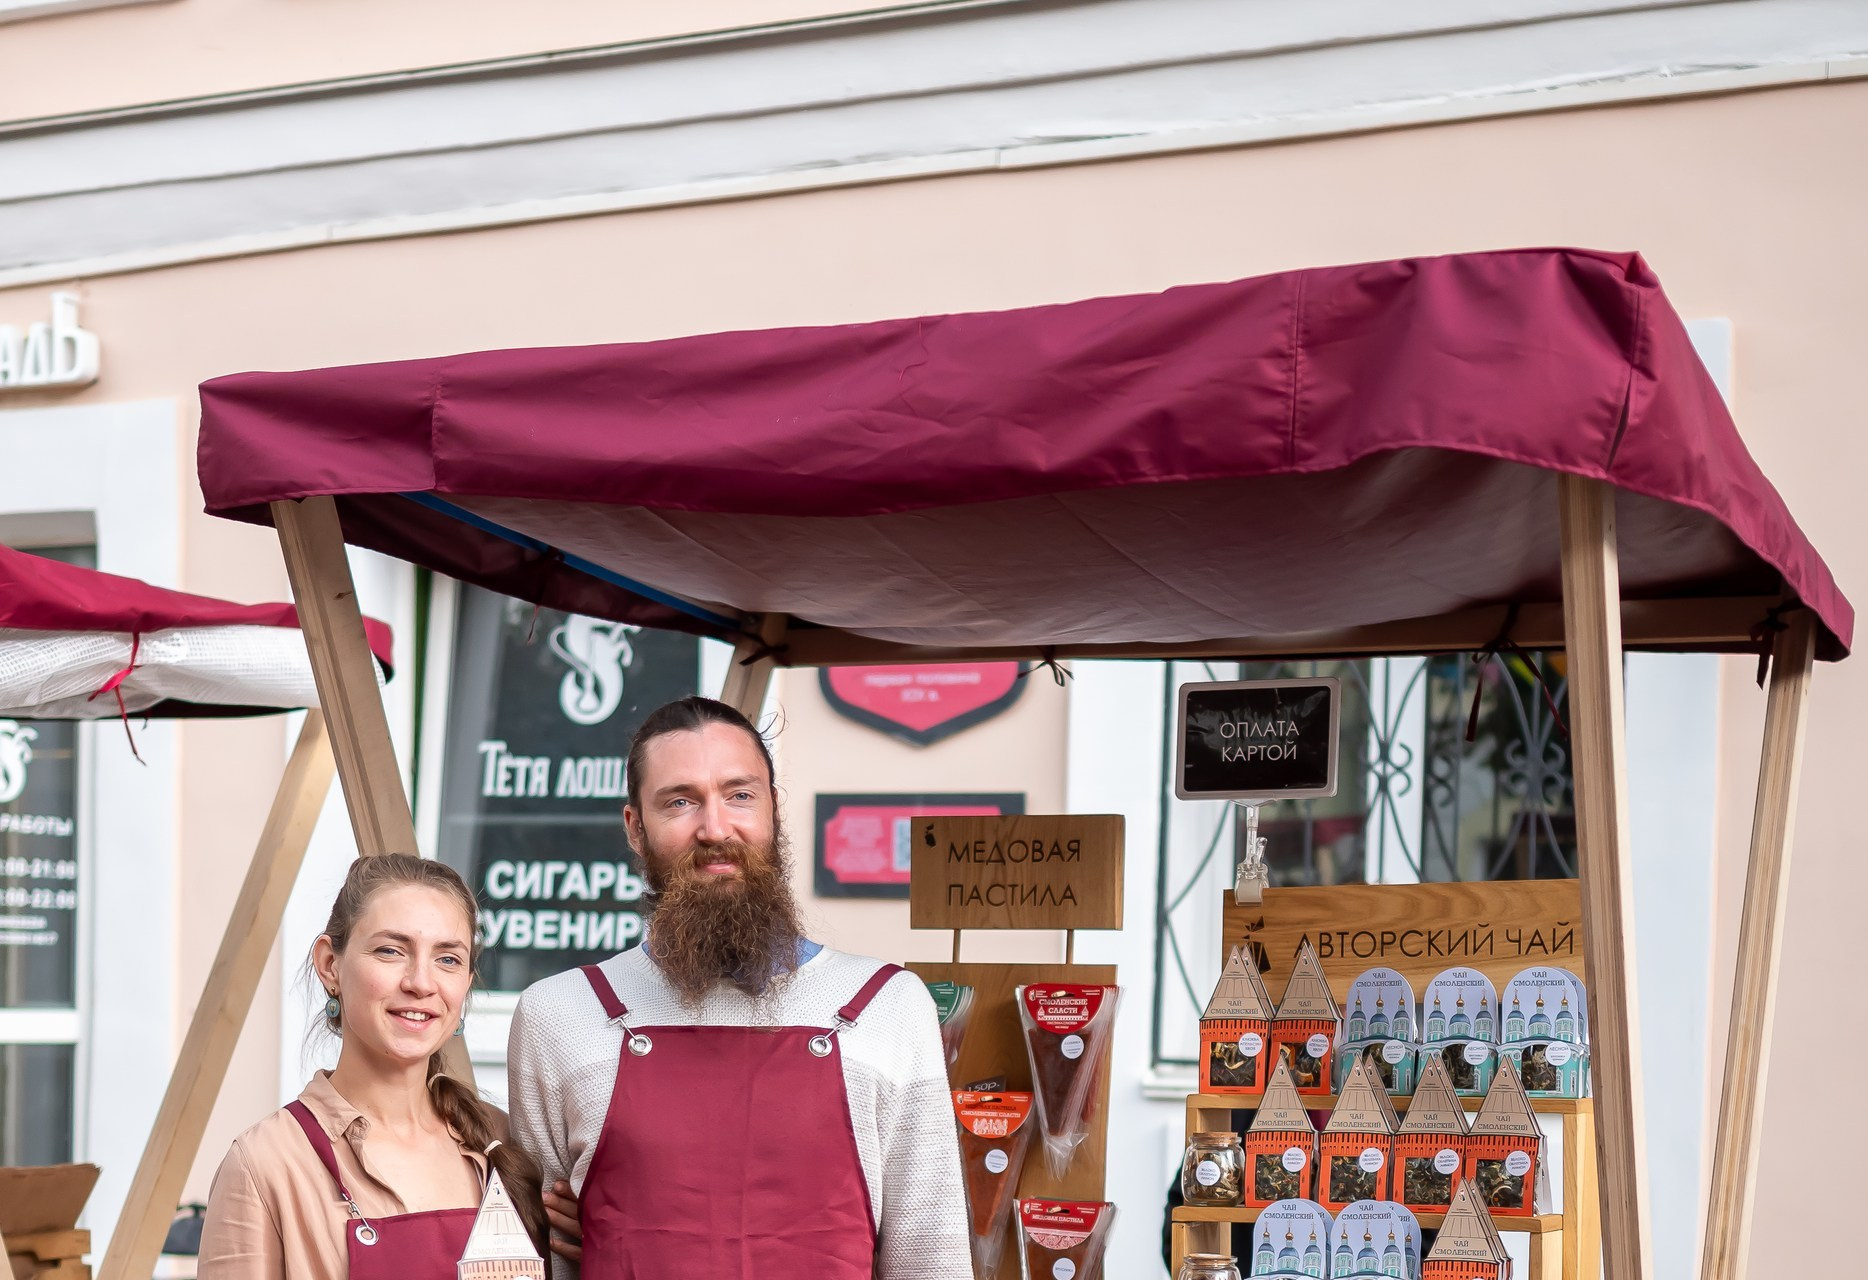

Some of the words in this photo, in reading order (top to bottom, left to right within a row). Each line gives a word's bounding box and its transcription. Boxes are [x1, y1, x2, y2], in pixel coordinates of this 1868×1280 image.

[1220, 720, 1300, 738] ОПЛАТА
[1222, 740, 1297, 762] КАРТОЙ
[948, 839, 1080, 865] МЕДОВАЯ
[0, 857, 77, 879] :00-21:00
[0, 887, 77, 909] :00-22:00
[948, 883, 1078, 906] ПАСТИЛА
[475, 908, 650, 950] УВЕНИР
[1293, 923, 1494, 958] АВТОРСКИЙ
[1505, 921, 1573, 955] ЧАЙ
[1452, 971, 1467, 979] ЧАЙ
[1513, 979, 1565, 987] СМОЛЕНСКИЙ
[1532, 970, 1547, 978] ЧАЙ
[1039, 998, 1088, 1006] СМОЛЕНСКИЕ
[1477, 1123, 1528, 1131] СМОЛЕНСКИЙ
[1341, 1212, 1392, 1220] СМОЛЕНСКИЙ
[1434, 1249, 1487, 1257] СМОЛЕНСКИЙ
